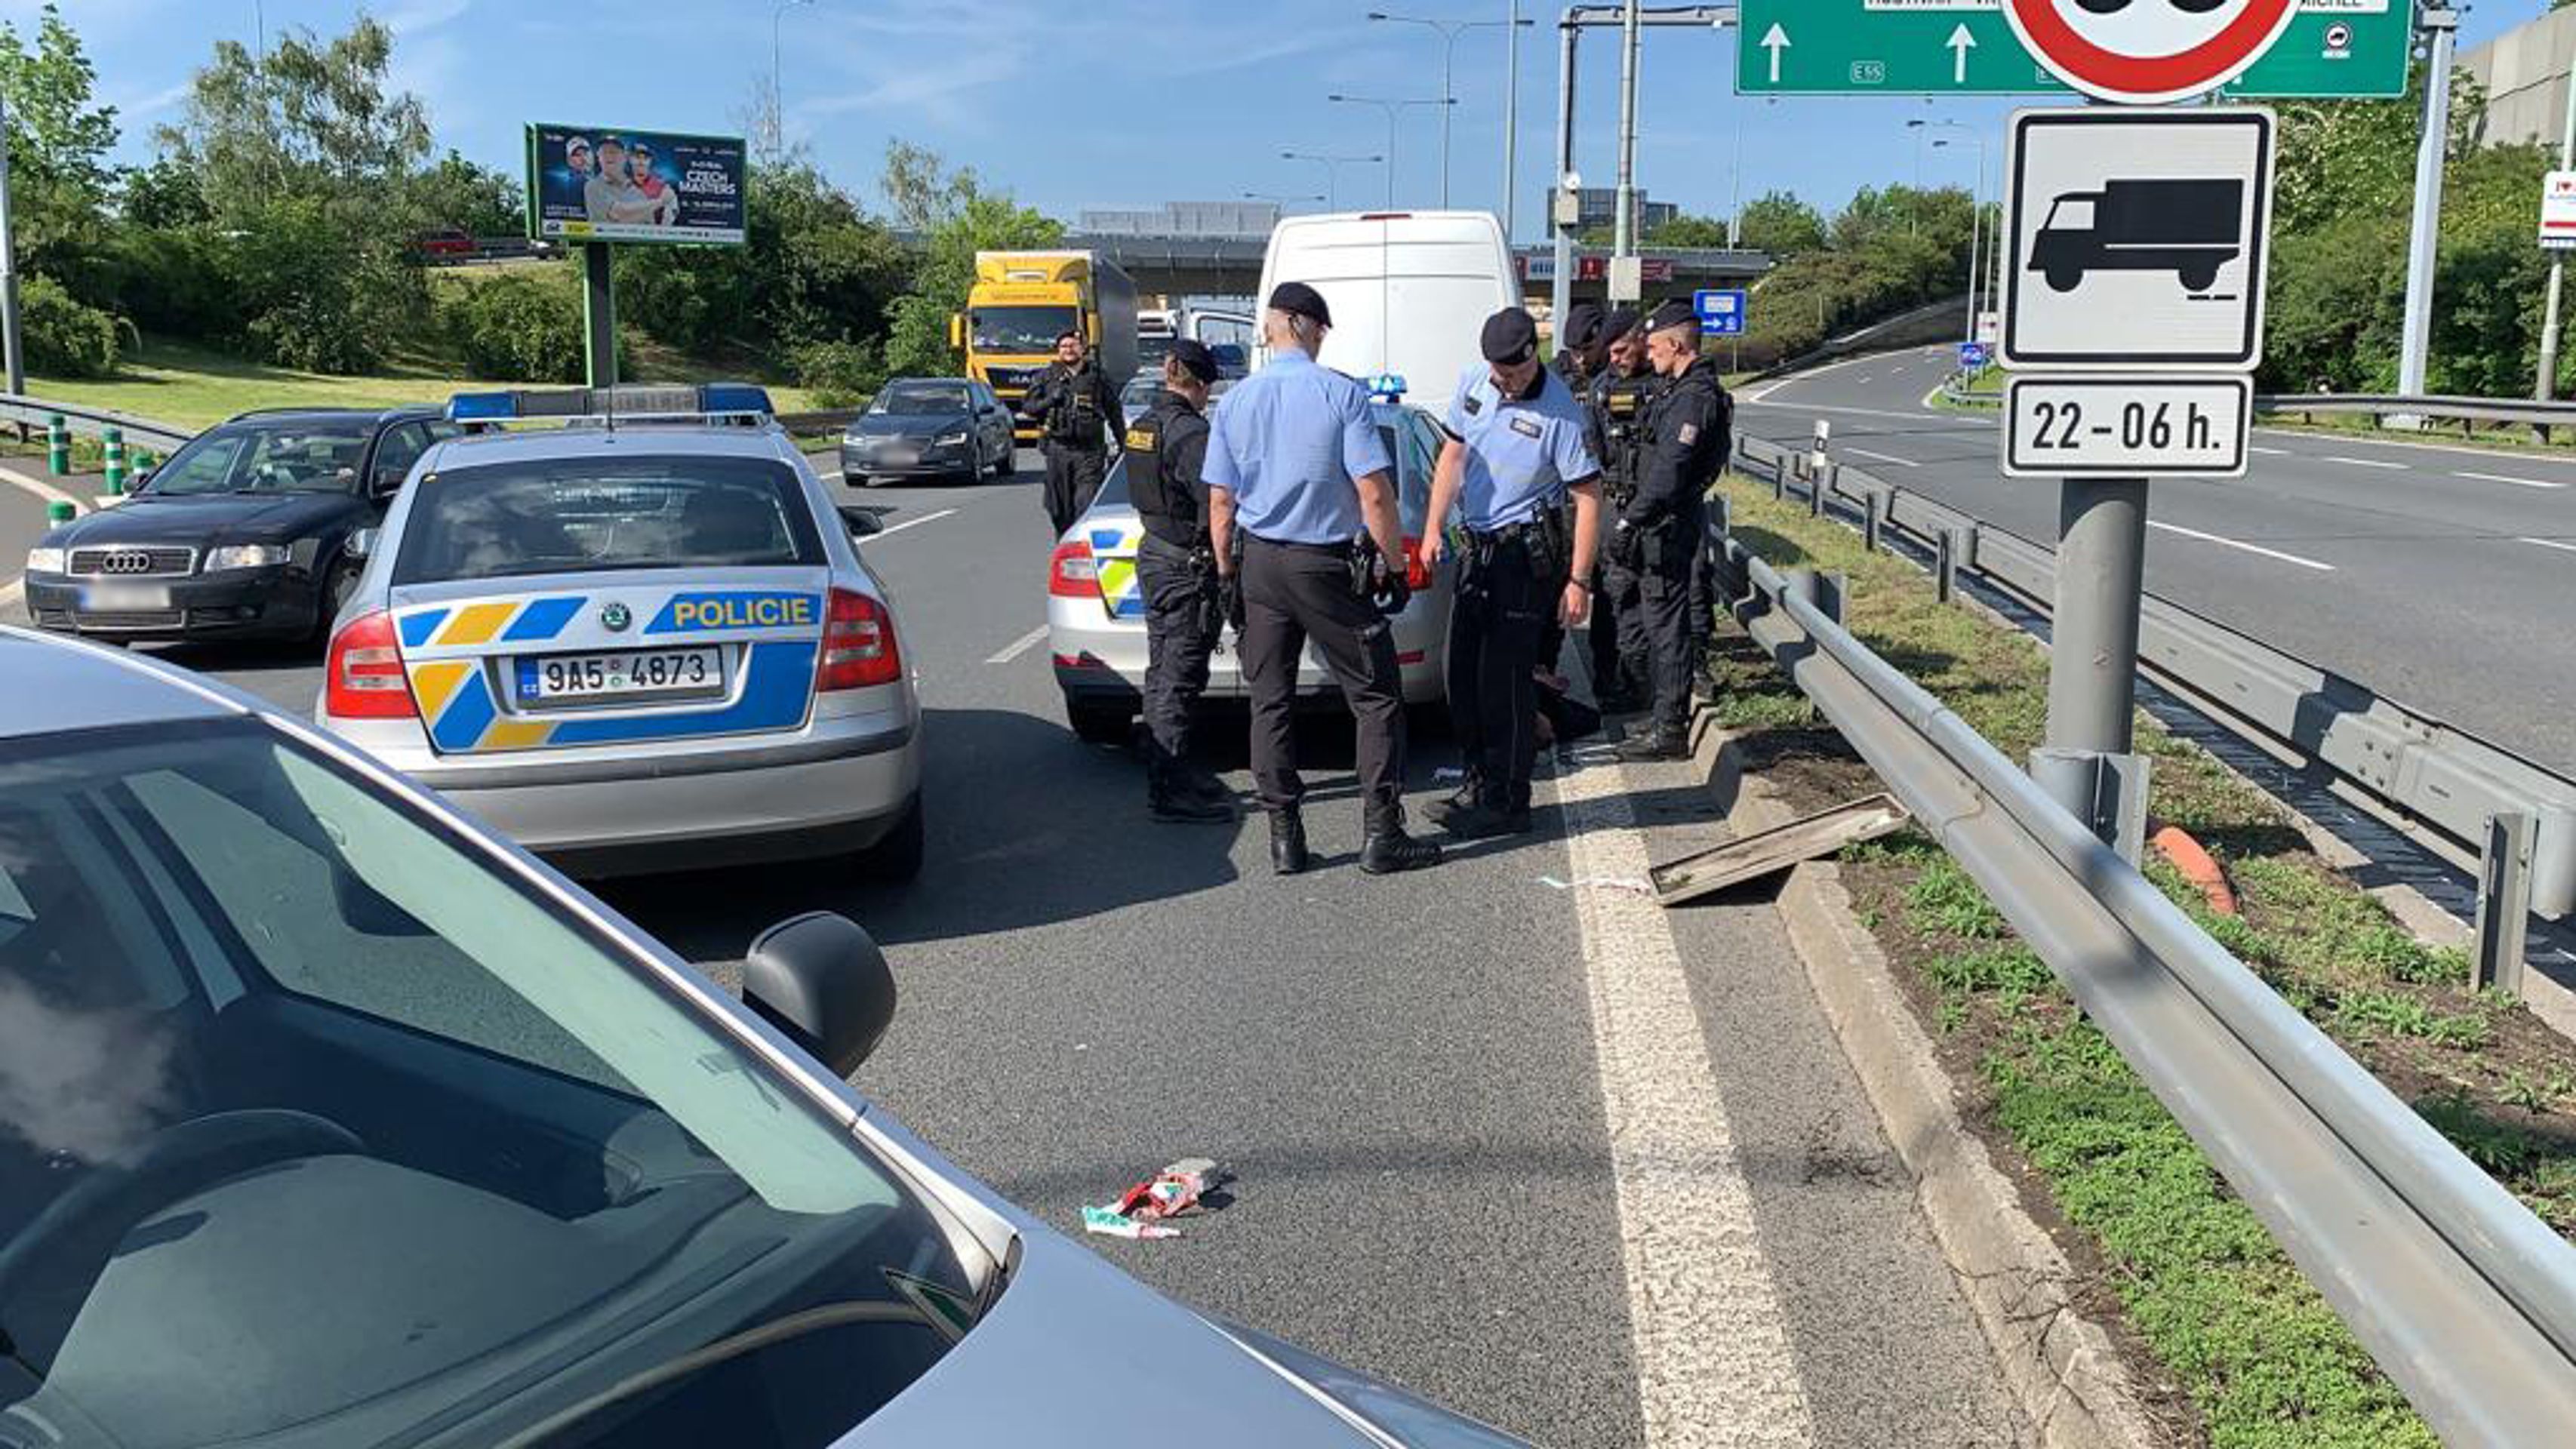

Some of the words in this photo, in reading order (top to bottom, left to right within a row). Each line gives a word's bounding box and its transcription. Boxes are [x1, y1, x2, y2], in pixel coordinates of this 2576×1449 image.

[2186, 401, 2221, 449] h.
[673, 598, 811, 628] POLICIE
[545, 660, 604, 692] 9A5
[630, 654, 706, 686] 4873
